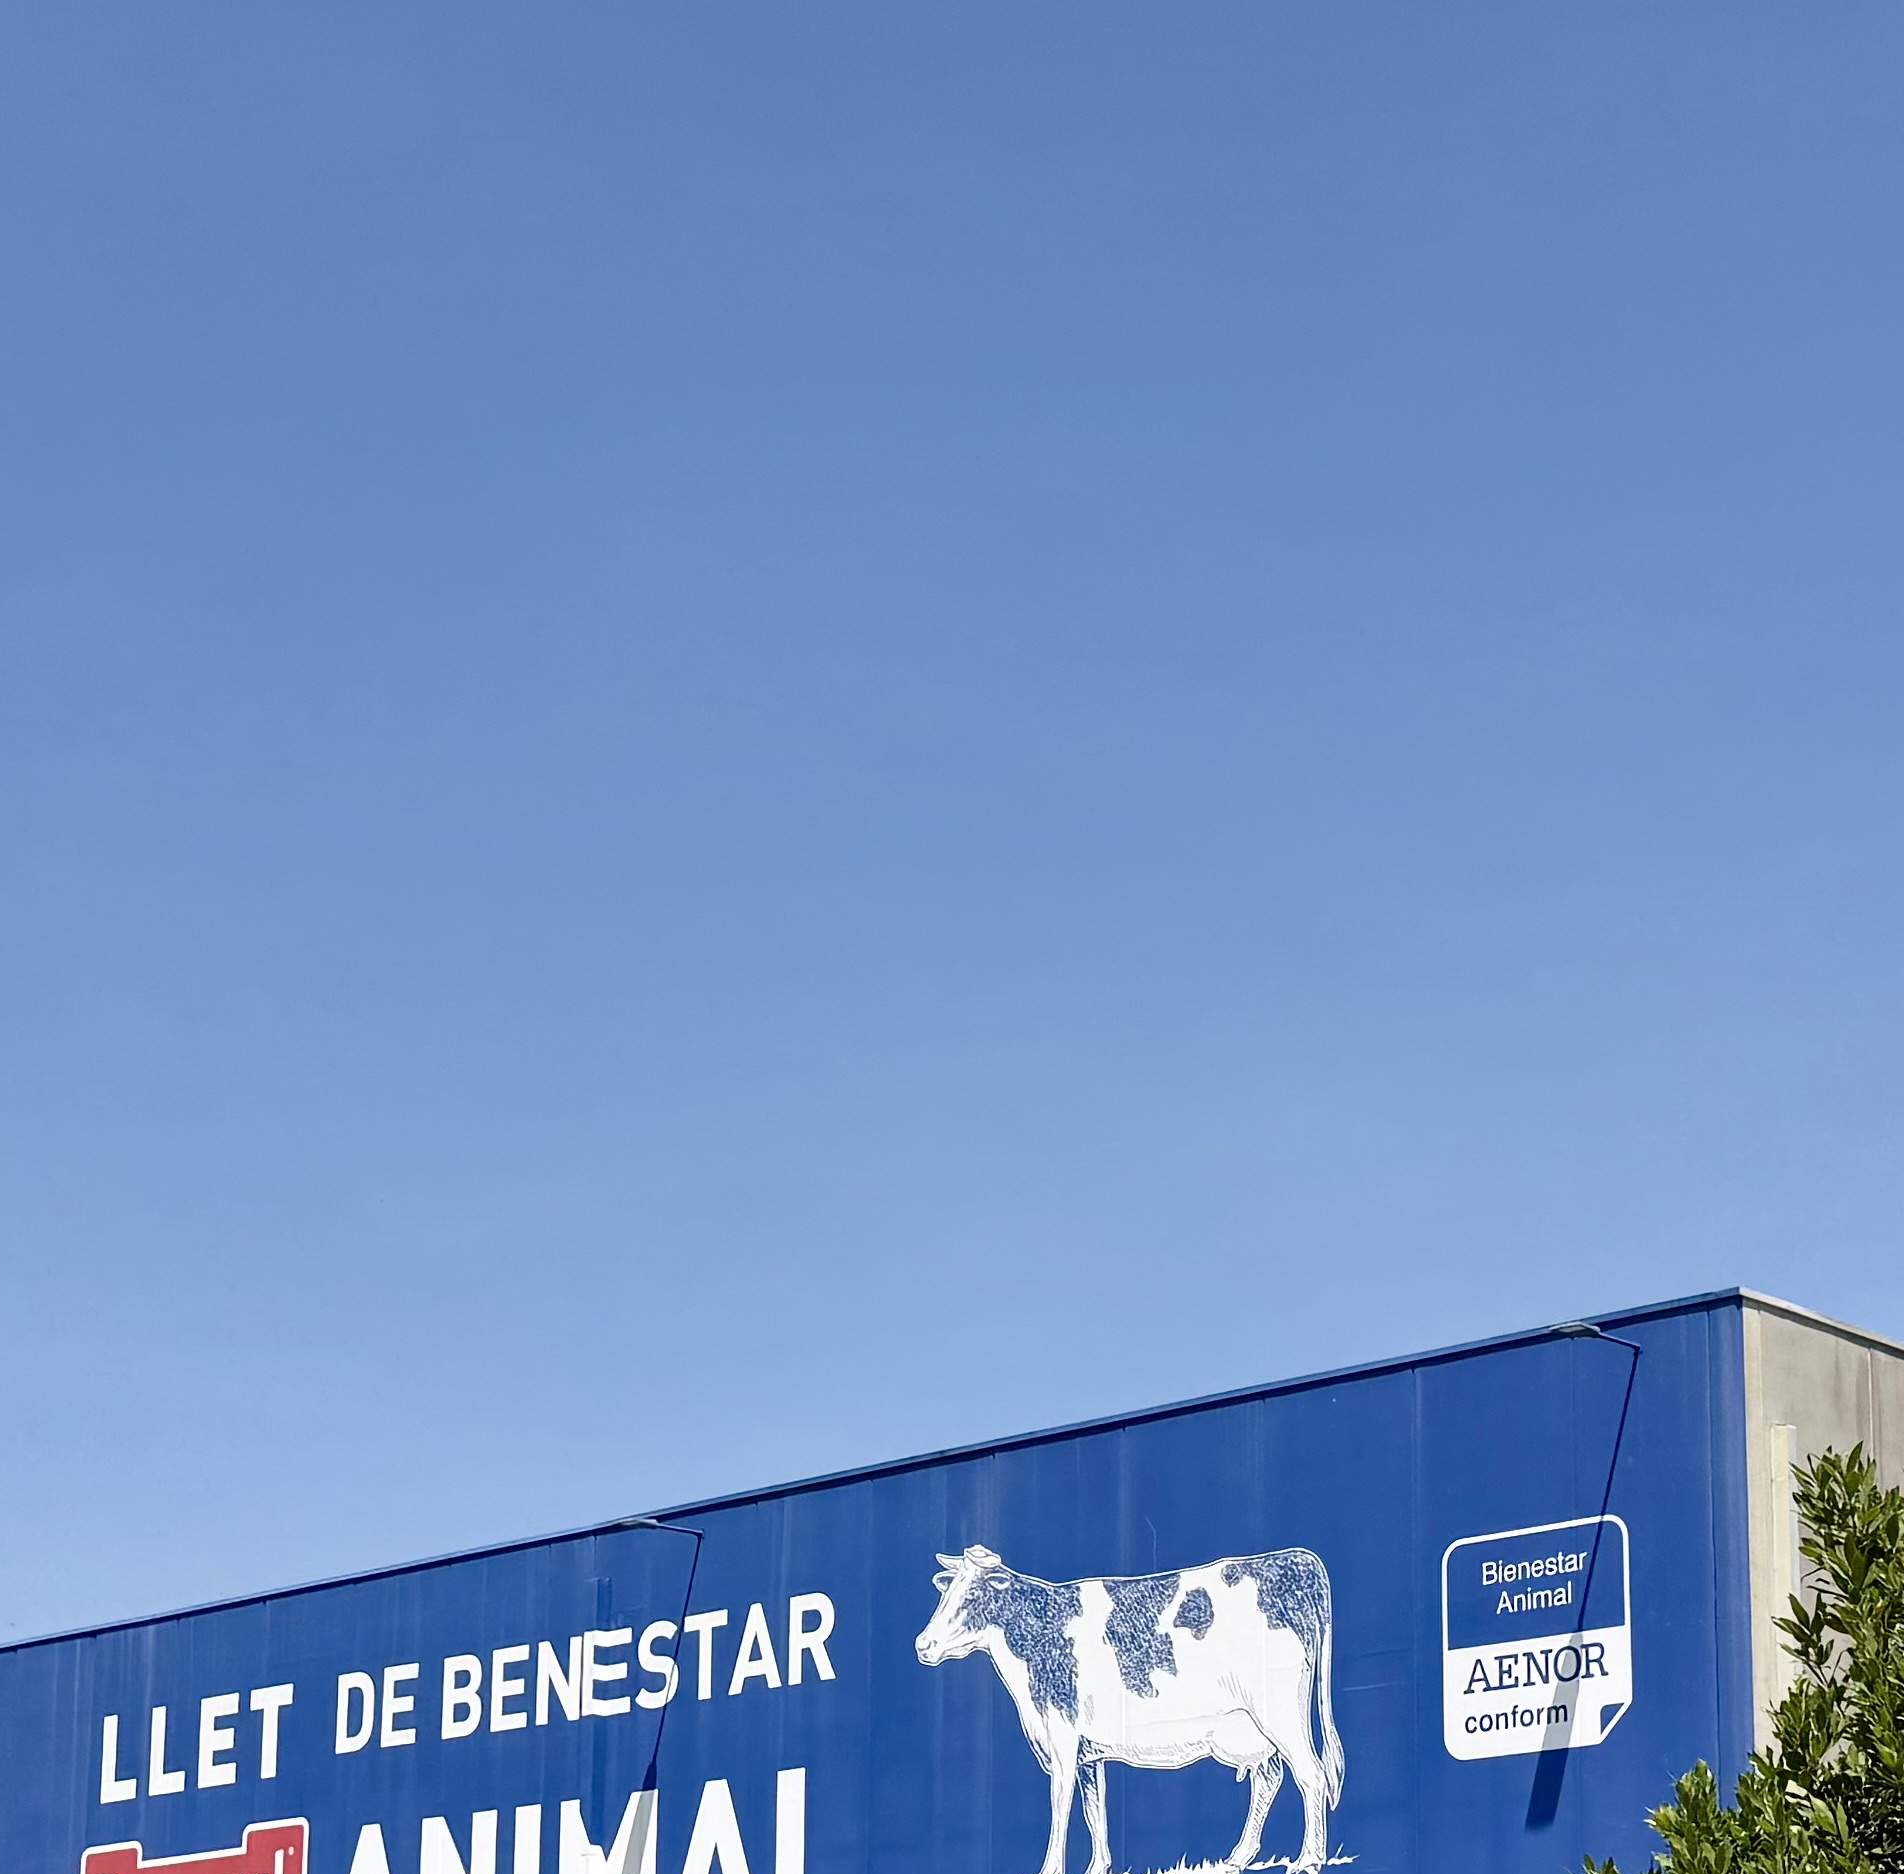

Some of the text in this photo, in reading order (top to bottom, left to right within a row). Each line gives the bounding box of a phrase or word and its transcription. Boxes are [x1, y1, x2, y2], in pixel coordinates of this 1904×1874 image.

[1482, 1551, 1588, 1586] Bienestar
[1496, 1581, 1572, 1615] Animal
[1463, 1642, 1608, 1695] AENOR
[100, 1591, 837, 1804] LLET DE BENESTAR
[1464, 1704, 1568, 1734] conform
